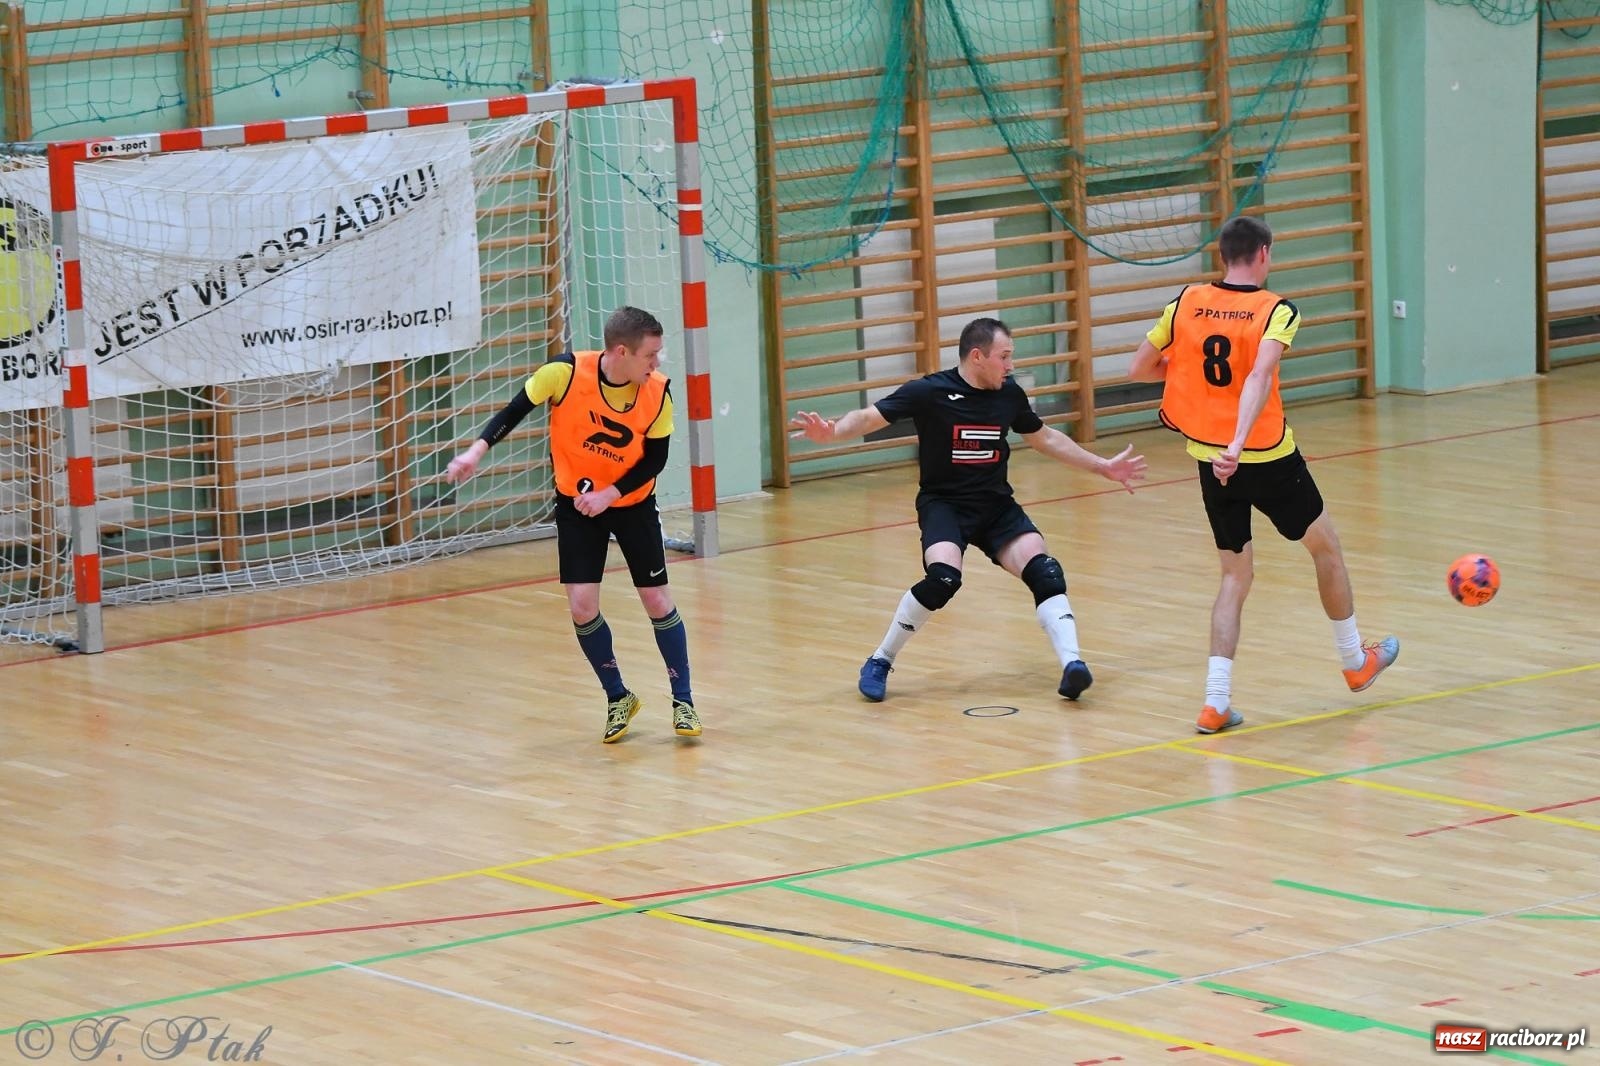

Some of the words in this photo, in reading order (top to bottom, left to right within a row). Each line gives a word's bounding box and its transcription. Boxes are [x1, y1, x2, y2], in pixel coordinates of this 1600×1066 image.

[94, 287, 179, 357] JEST
[190, 265, 228, 307] W
[241, 301, 452, 348] www.osir-raciborz.pl
[1205, 308, 1255, 321] PATRICK
[1202, 334, 1232, 388] 8
[582, 441, 625, 463] PATRICK
